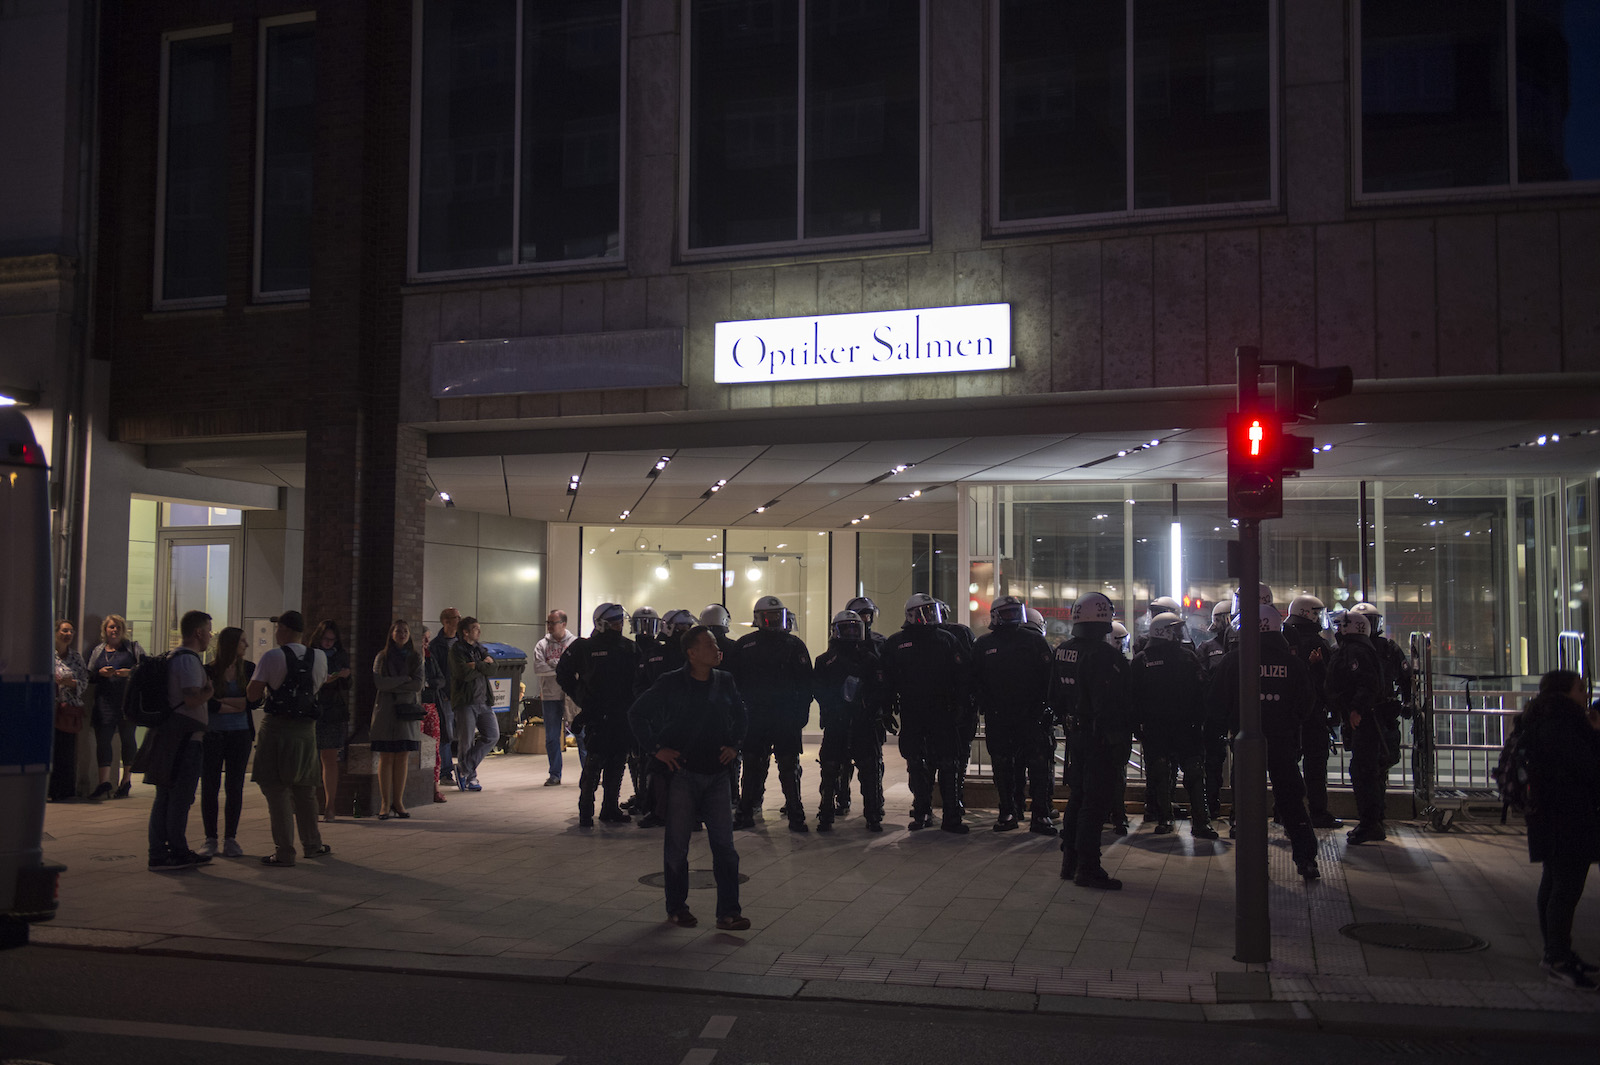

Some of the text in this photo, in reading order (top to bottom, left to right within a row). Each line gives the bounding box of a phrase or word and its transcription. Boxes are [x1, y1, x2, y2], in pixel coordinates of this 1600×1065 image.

[732, 314, 993, 375] Optiker Salmen
[1095, 602, 1108, 612] 32
[1355, 621, 1366, 630] 32
[1154, 627, 1165, 637] 32
[1055, 648, 1079, 663] POLIZEI
[1259, 664, 1288, 678] OLIZEI
